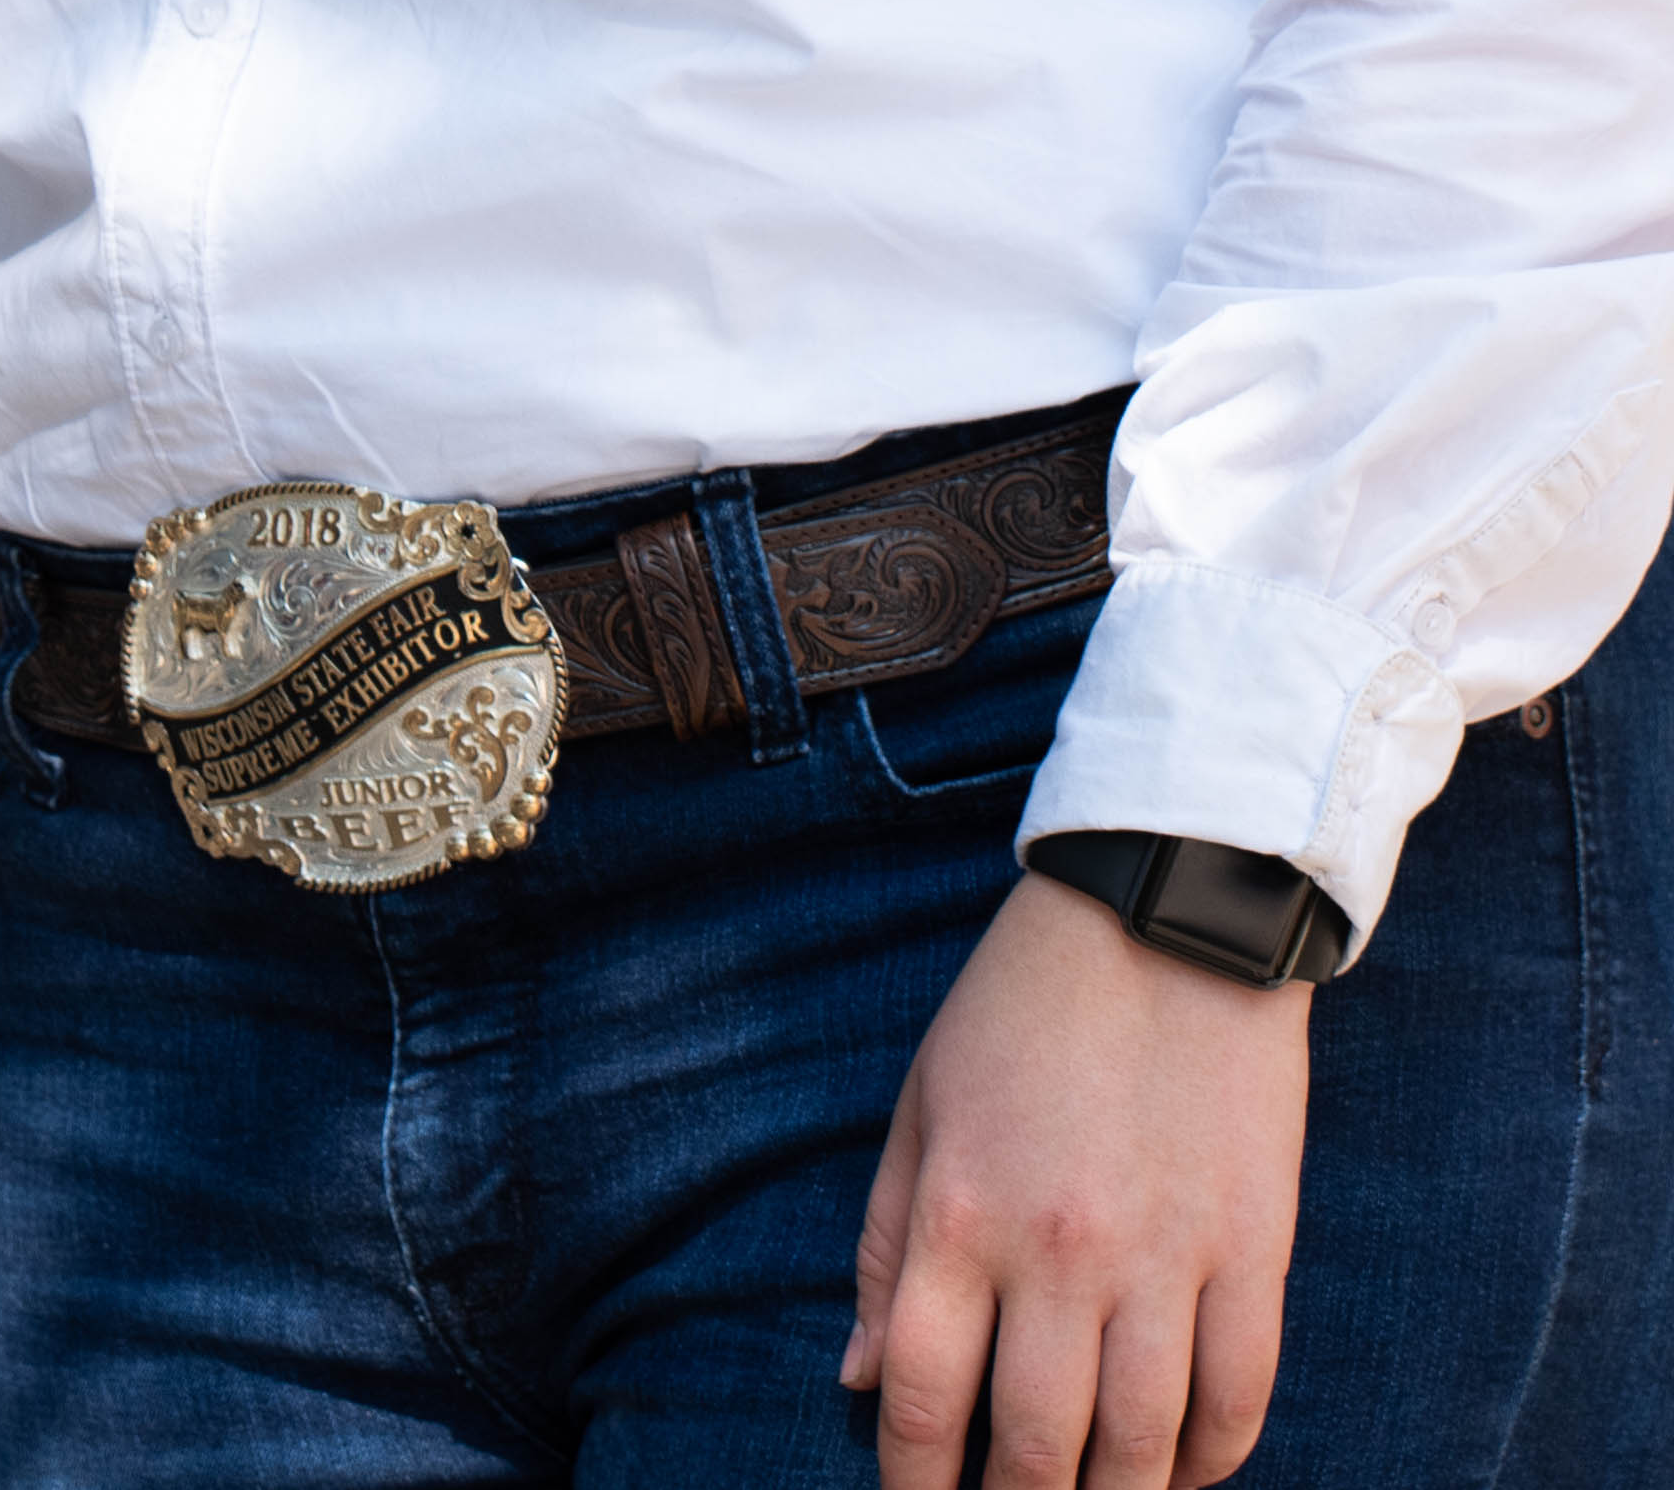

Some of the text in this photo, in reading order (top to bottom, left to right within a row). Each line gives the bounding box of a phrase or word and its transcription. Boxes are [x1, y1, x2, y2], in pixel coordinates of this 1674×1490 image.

[249, 506, 342, 549] 2018
[178, 584, 447, 763] WISCONSIN STATE FAIR
[201, 608, 490, 794] SUPREME EXHIBITOR
[321, 770, 455, 808] JUNIOR
[278, 800, 473, 851] BEEF
